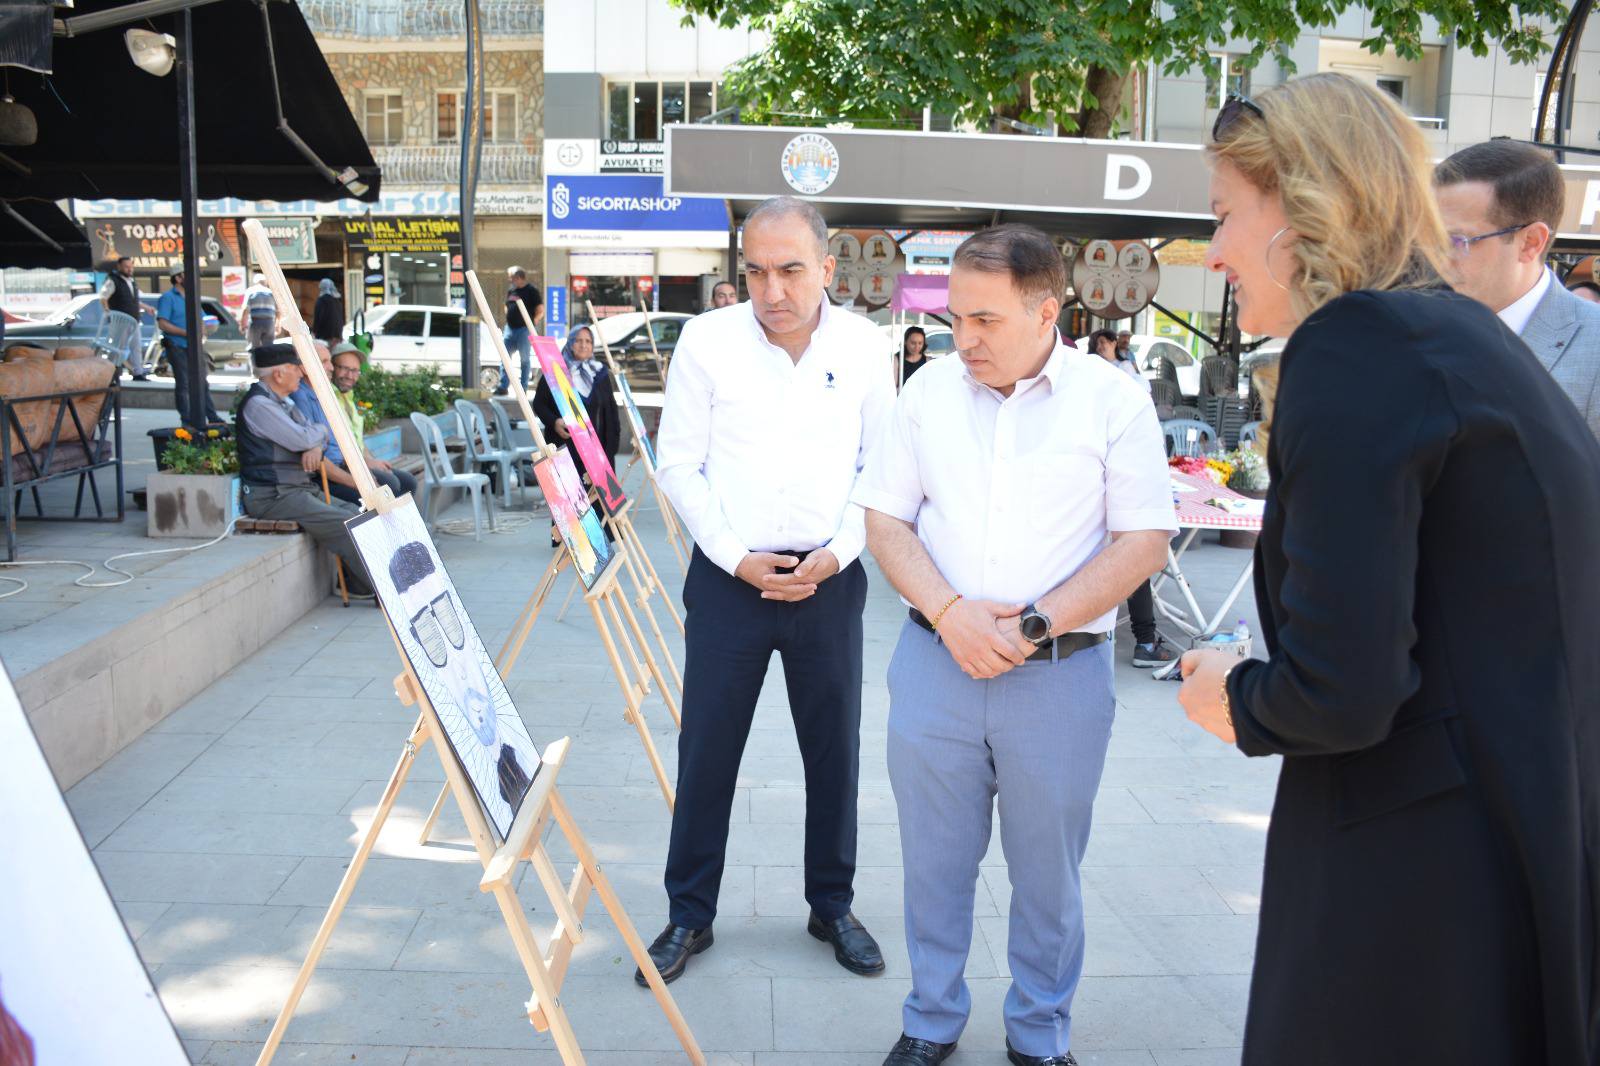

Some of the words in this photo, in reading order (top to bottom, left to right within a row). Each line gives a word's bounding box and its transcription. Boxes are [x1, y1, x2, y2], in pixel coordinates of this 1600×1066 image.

[604, 158, 644, 168] AVUKAT
[1103, 153, 1152, 200] D
[396, 218, 460, 236] İLETİŞİM
